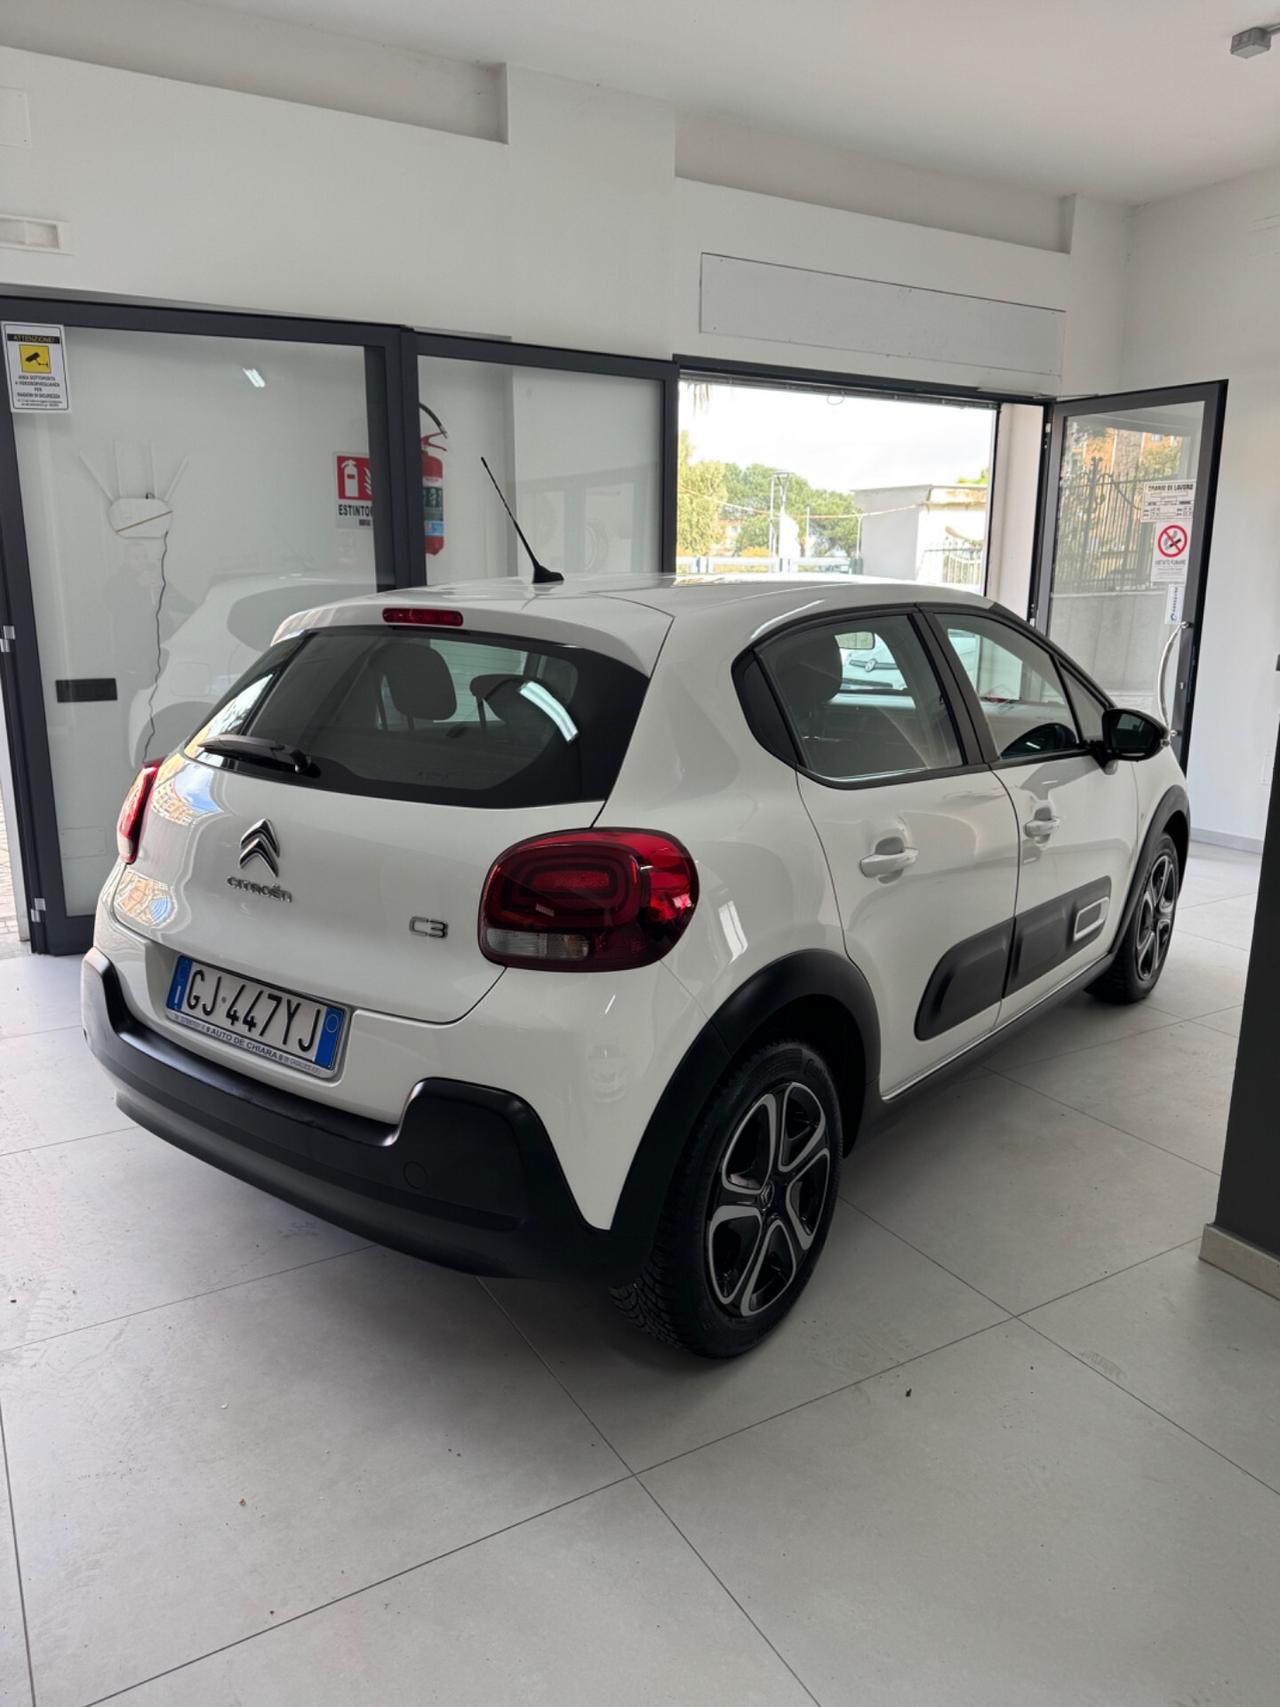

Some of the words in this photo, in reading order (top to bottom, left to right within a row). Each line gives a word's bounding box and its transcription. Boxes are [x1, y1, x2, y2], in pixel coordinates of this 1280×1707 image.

[338, 504, 372, 517] ESTINTO
[409, 915, 449, 939] C3
[210, 1029, 232, 1042] AUTO
[233, 1036, 246, 1047] DE
[246, 1040, 278, 1061] CHIARA
